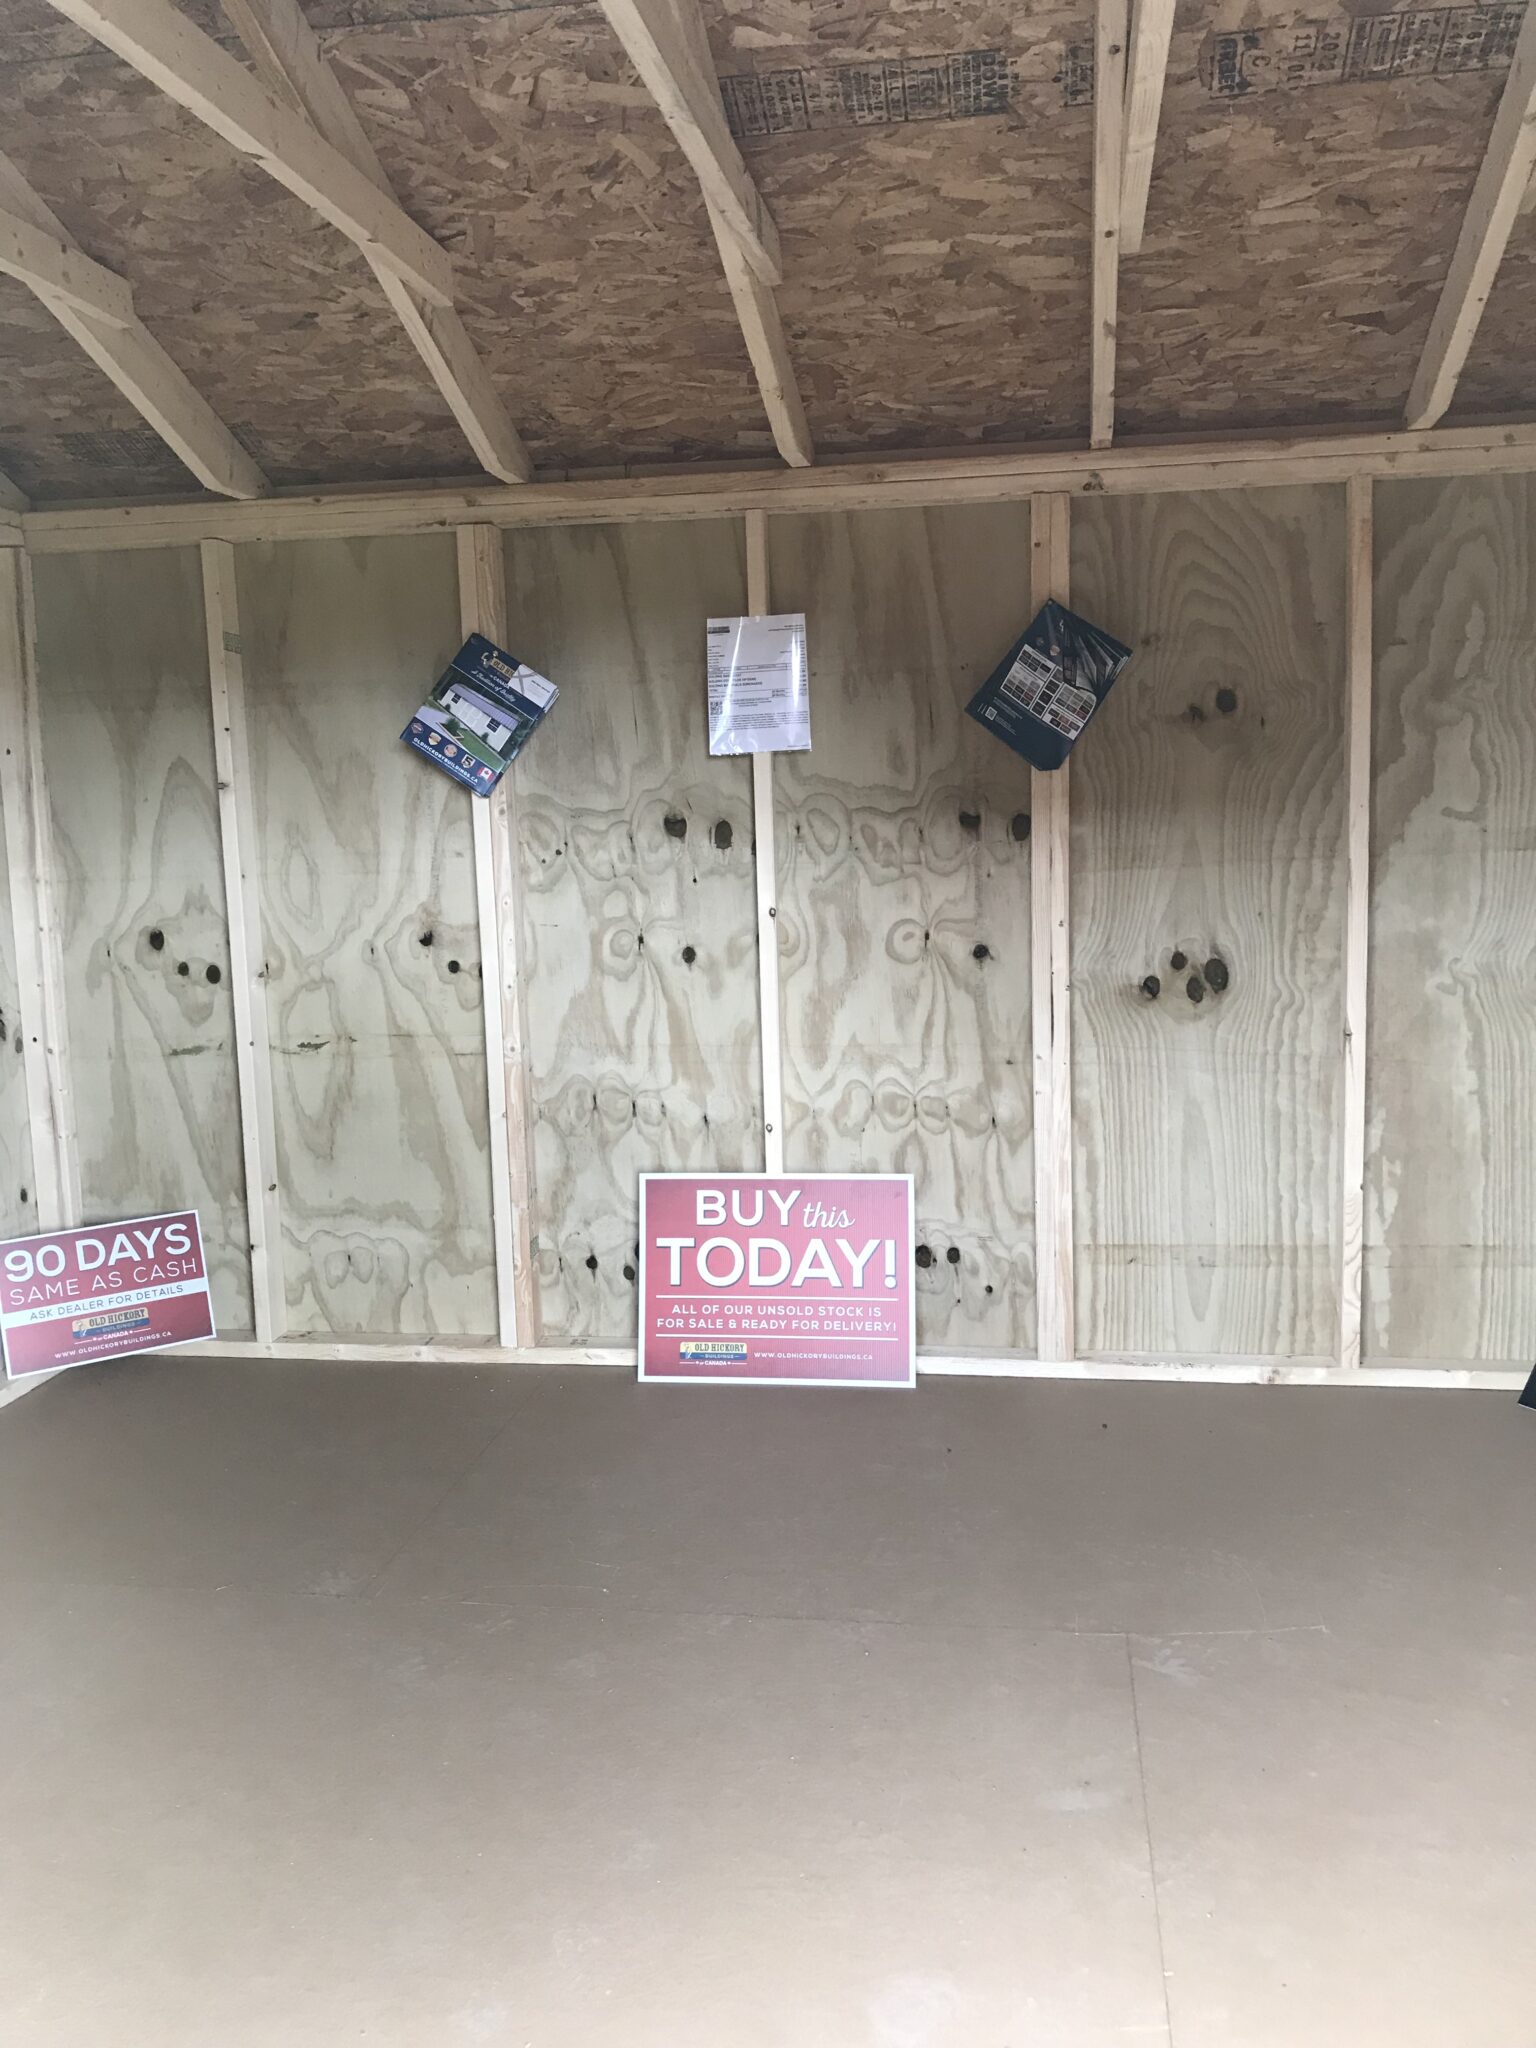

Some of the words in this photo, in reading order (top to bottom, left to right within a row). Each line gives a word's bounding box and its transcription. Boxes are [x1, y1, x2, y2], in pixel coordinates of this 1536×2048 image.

[696, 1189, 802, 1227] BUY
[803, 1202, 855, 1228] this
[4, 1244, 66, 1283] 90
[75, 1223, 192, 1272] DAYS
[656, 1236, 898, 1289] TODAY!
[10, 1278, 80, 1306] SAME
[92, 1271, 123, 1291] AS
[133, 1257, 197, 1283] CASH
[29, 1309, 54, 1321] ASK
[58, 1299, 104, 1316] DEALER
[108, 1294, 132, 1307] FOR
[136, 1284, 184, 1301] DETAILS
[671, 1304, 698, 1315] ALL
[701, 1304, 720, 1315] OF
[724, 1305, 753, 1315] OUR
[757, 1305, 814, 1316] UNSOLD
[818, 1306, 864, 1317] STOCK
[868, 1307, 882, 1317] IS
[89, 1316, 106, 1327] OLD
[107, 1308, 146, 1324] HICKORY
[656, 1318, 684, 1328] FOR
[688, 1318, 724, 1329] SALE
[727, 1319, 737, 1329] &
[741, 1319, 787, 1330] READY
[791, 1320, 820, 1330] FOR
[823, 1320, 897, 1332] DELIVERY!
[103, 1330, 129, 1340] CANADA
[694, 1343, 710, 1352] OLD
[711, 1343, 745, 1352] HICKORY
[753, 1352, 873, 1360] WWW.OLDHICKORYBUILDINGS.CA
